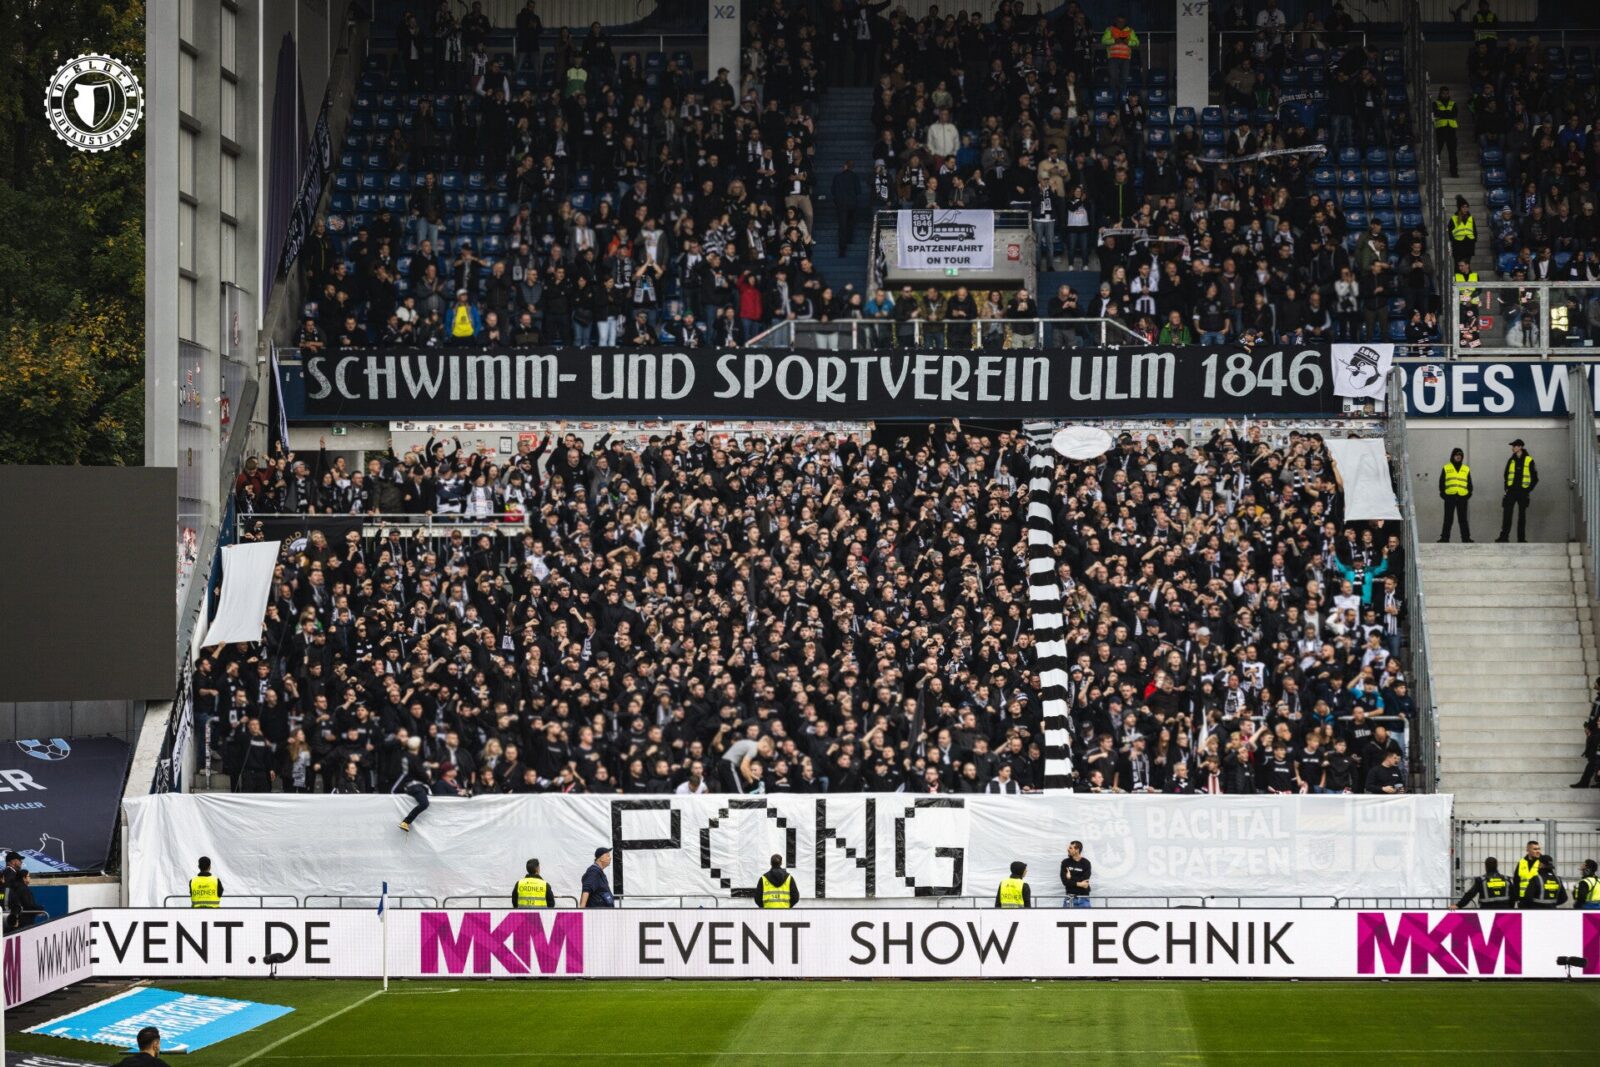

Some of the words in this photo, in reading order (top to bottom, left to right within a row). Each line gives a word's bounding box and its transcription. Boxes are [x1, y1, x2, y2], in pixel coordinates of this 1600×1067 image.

[714, 5, 735, 19] X2
[907, 244, 984, 253] SPATZENFAHRT
[926, 256, 941, 264] ON
[943, 256, 971, 264] TOUR
[713, 353, 1050, 402] SPORTVEREIN
[1201, 350, 1324, 398] 1846
[1146, 805, 1291, 841] BACHTAL
[610, 798, 965, 899] PONG
[1147, 845, 1291, 878] SPATZEN
[519, 885, 545, 893] ORDNER
[420, 911, 584, 974] MKM
[638, 921, 811, 965] EVENT
[849, 920, 1019, 966] SHOW
[1056, 920, 1295, 965] TECHNIK
[1357, 912, 1523, 975] MKM
